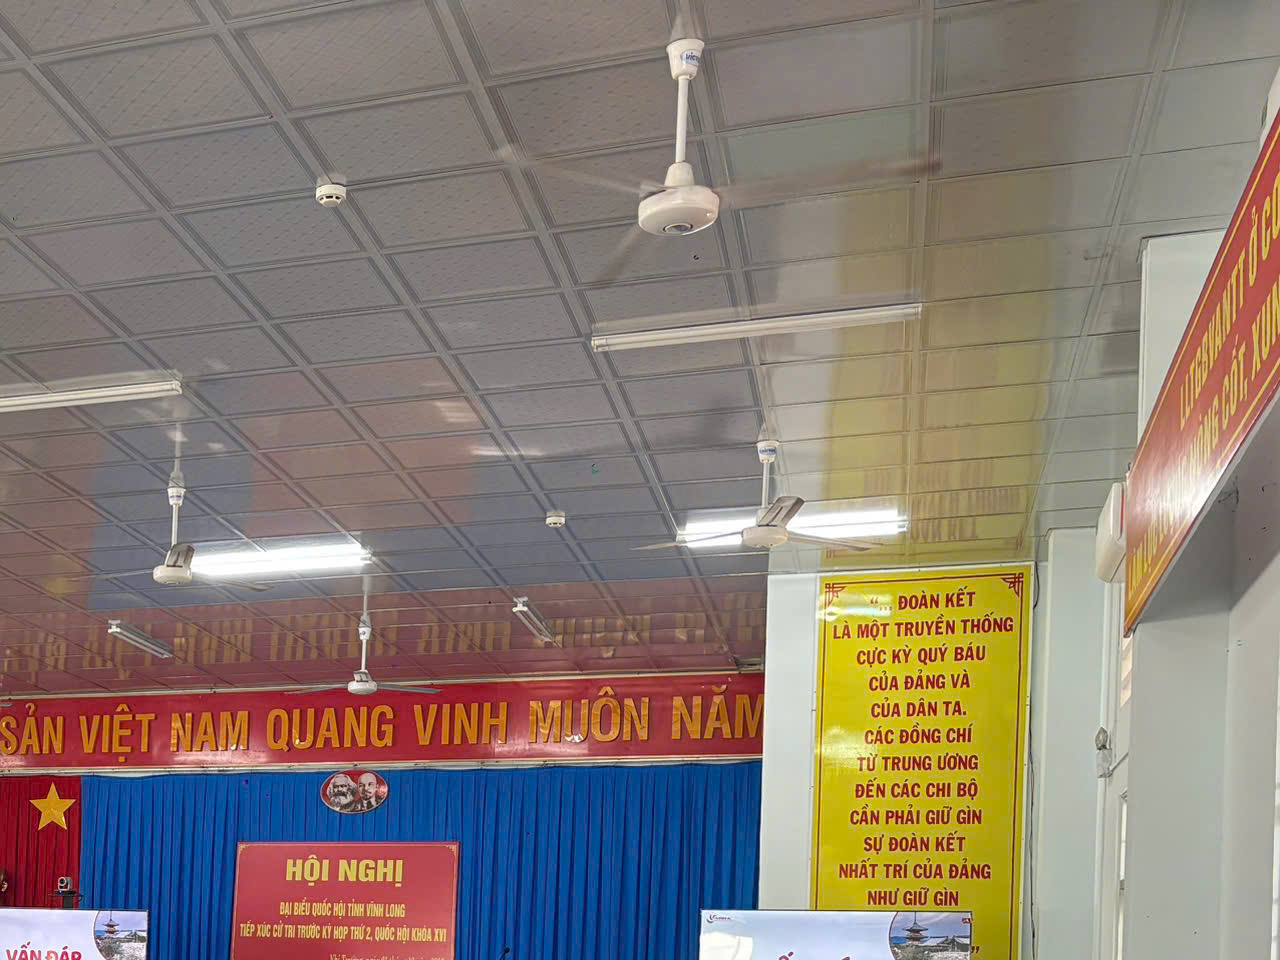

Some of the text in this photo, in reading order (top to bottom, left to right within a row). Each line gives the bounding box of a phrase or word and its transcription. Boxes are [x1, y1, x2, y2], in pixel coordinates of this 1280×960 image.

[898, 593, 939, 610] ĐOÀN
[945, 586, 976, 608] KẾT
[833, 612, 1014, 641] LÀ MỘT TRUYỀN THỐNG
[856, 642, 986, 667] CỰC KỲ QUÝ BÁU
[869, 669, 970, 691] CỦA ĐẢNG VÀ
[871, 697, 967, 718] CỦA DÂN TA.
[0, 702, 64, 756] SẢN
[79, 704, 157, 763] VIỆT
[170, 710, 250, 752] NAM
[267, 705, 394, 752] QUANG
[414, 701, 508, 746] VINH
[528, 686, 649, 744] MUÔN
[671, 684, 764, 740] NĂM
[865, 722, 973, 745] CÁC ĐỒNG CHÍ
[857, 753, 979, 772] TỪ TRUNG ƯƠNG
[855, 777, 978, 800] ĐẾN CÁC CHI BỘ
[850, 804, 982, 825] CẦN PHẢI GIỮ GÌN
[864, 831, 966, 855] SỰ ĐOÀN KẾT
[286, 854, 404, 887] HỘI NGHỊ
[839, 858, 991, 879] NHẤT TRÍ CỦA ĐẢNG
[280, 897, 405, 919] ĐẠI BIỂU QUỐC HỘI TỈNH VĨNH LONG
[867, 887, 959, 906] NHƯ GIỮ GÌN
[240, 920, 447, 944] TIẾP XÚC CỬ TRI TRƯỚC KỲ HỌP THỨ 2, QUỐC HỘI KHÓA XVI
